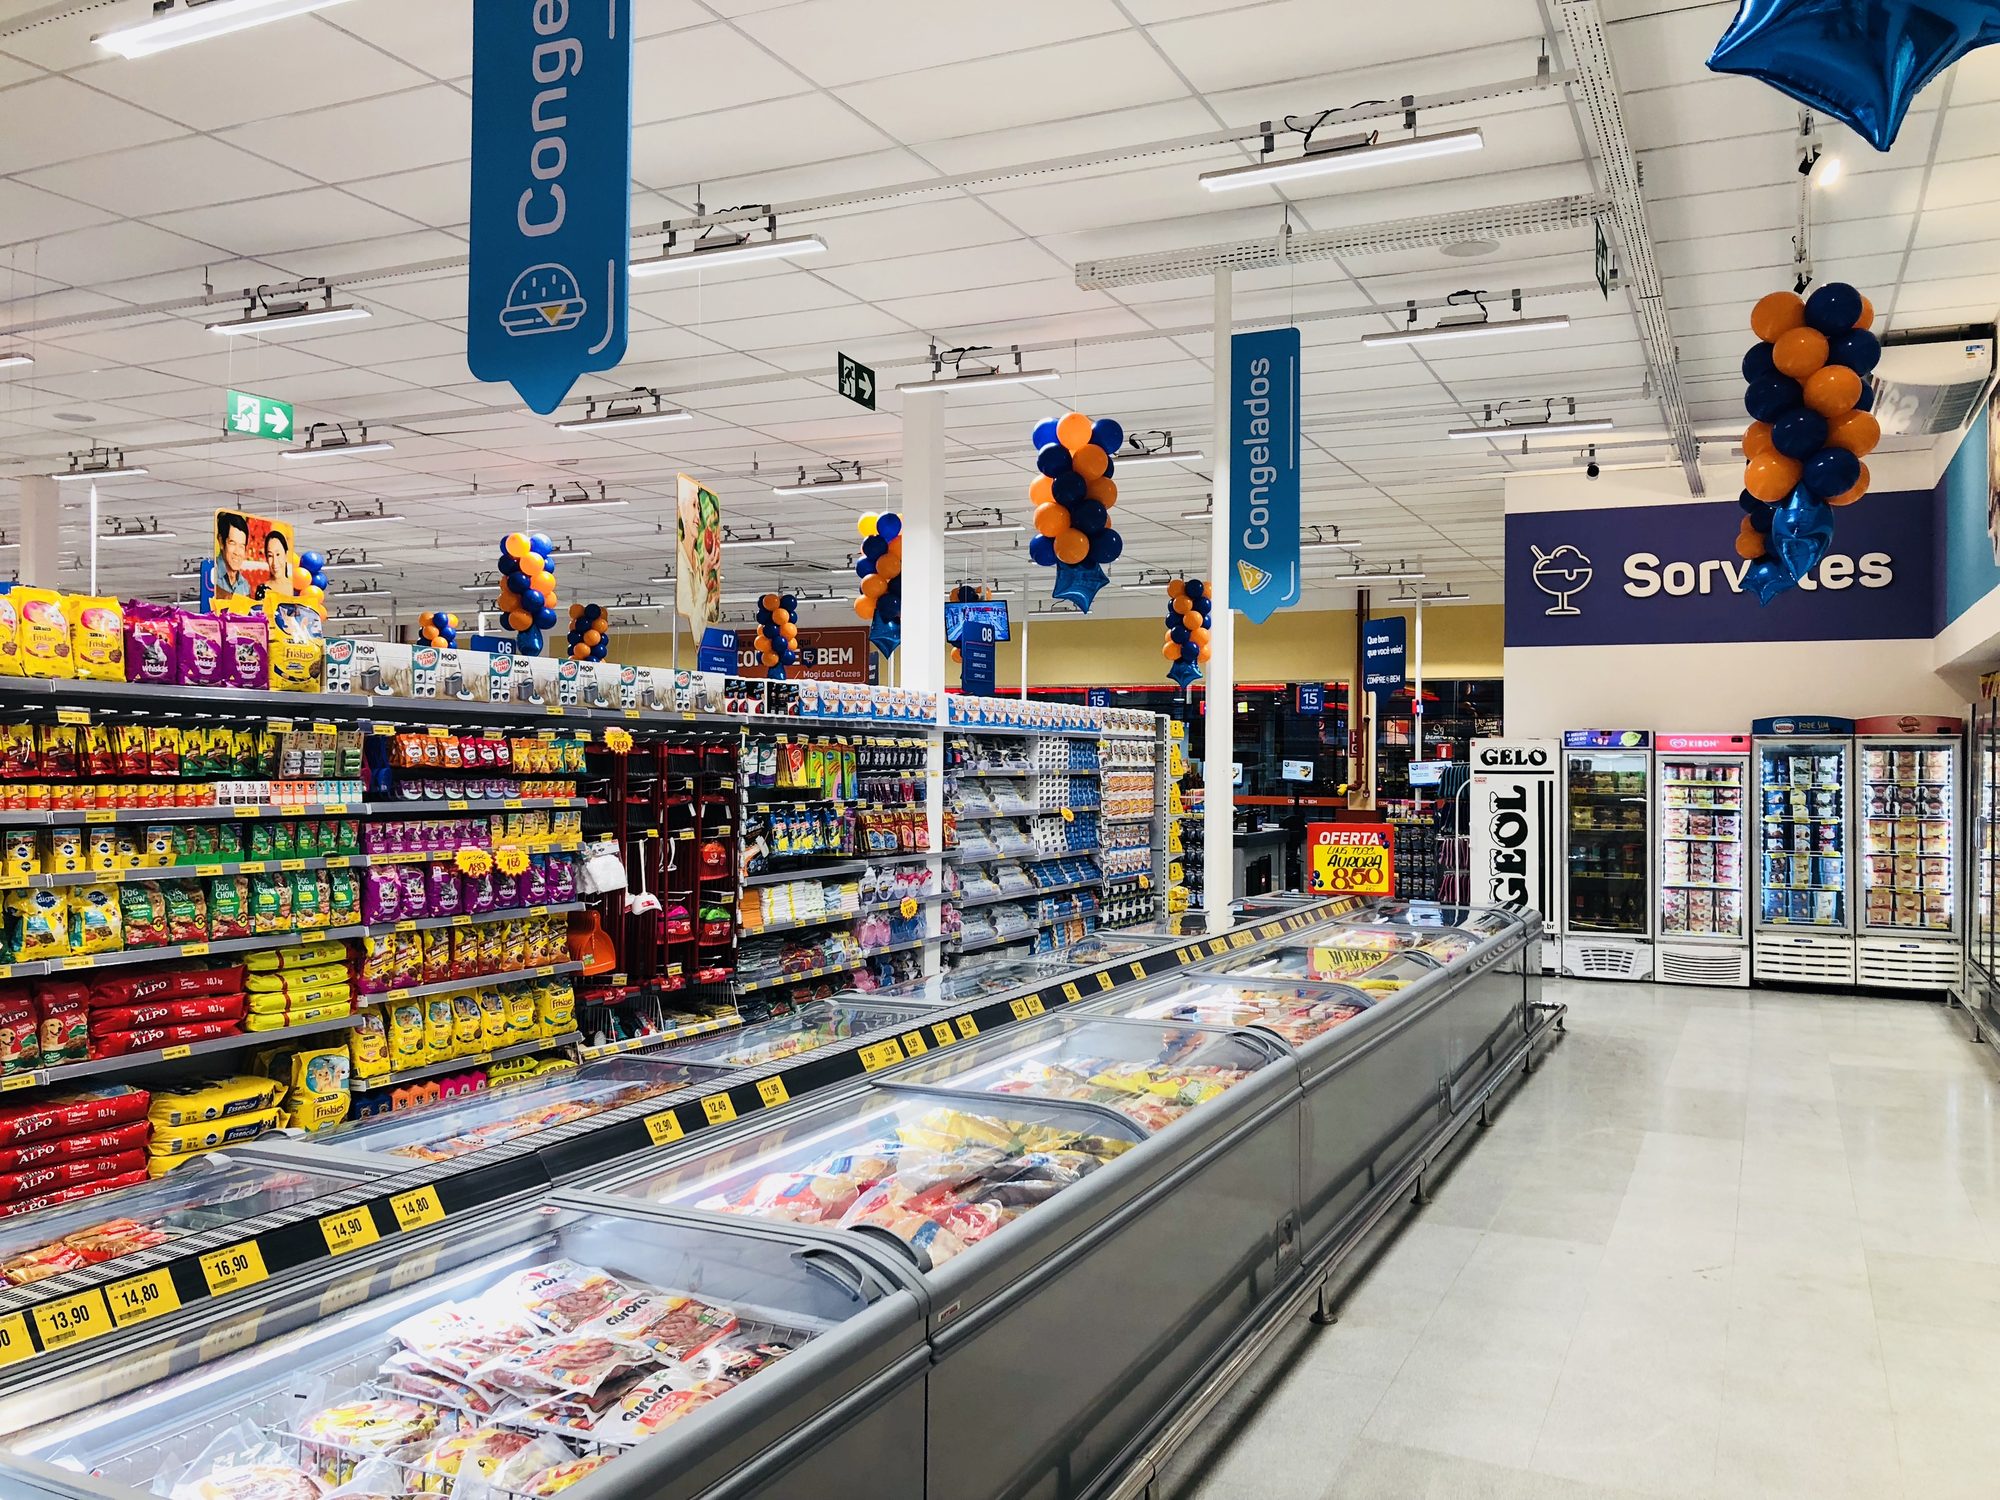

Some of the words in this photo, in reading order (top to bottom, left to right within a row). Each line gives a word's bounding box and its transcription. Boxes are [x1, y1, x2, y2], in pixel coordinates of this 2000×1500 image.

[1243, 357, 1276, 550] Congelados
[1623, 551, 1893, 598] Sorves
[722, 634, 735, 648] 07
[981, 627, 993, 642] 08
[1367, 635, 1378, 645] Que
[285, 648, 314, 660] Friskies
[356, 646, 375, 655] MOP
[497, 641, 512, 653] 06
[1367, 649, 1377, 659] que
[441, 652, 457, 662] MOP
[818, 647, 853, 665] BEM
[514, 659, 529, 668] MOP
[803, 671, 821, 680] Mogi
[822, 671, 834, 679] das
[1367, 676, 1386, 685] COMPRE
[1390, 675, 1401, 683] BEM
[1091, 695, 1104, 706] 15
[1303, 692, 1318, 705] 15
[1480, 747, 1547, 766] GELO
[1319, 832, 1380, 845] OFERTA
[1327, 854, 1382, 868] AURORA
[215, 883, 229, 892] DOG
[215, 890, 235, 899] CHOW
[135, 981, 167, 998] ALPO
[50, 1002, 79, 1015] ALPO
[1, 1011, 28, 1025] ALPO
[135, 1008, 168, 1024] ALPO
[132, 1030, 164, 1047] ALPO
[763, 1083, 779, 1097] 11,99
[227, 1101, 257, 1114] Essencial
[316, 1105, 344, 1117] Friskies
[708, 1101, 727, 1113] 12,49
[15, 1118, 52, 1138] ALPO
[653, 1119, 672, 1133] 12,90
[228, 1128, 257, 1140] Essencial
[19, 1145, 55, 1164] ALPO
[18, 1171, 55, 1192] ALPO
[402, 1197, 430, 1216] 14,80
[332, 1218, 362, 1239] 14,90
[214, 1254, 249, 1277] 16,90
[121, 1283, 159, 1307] 14,80
[49, 1304, 90, 1331] 13,90
[622, 1384, 673, 1423] aurora
